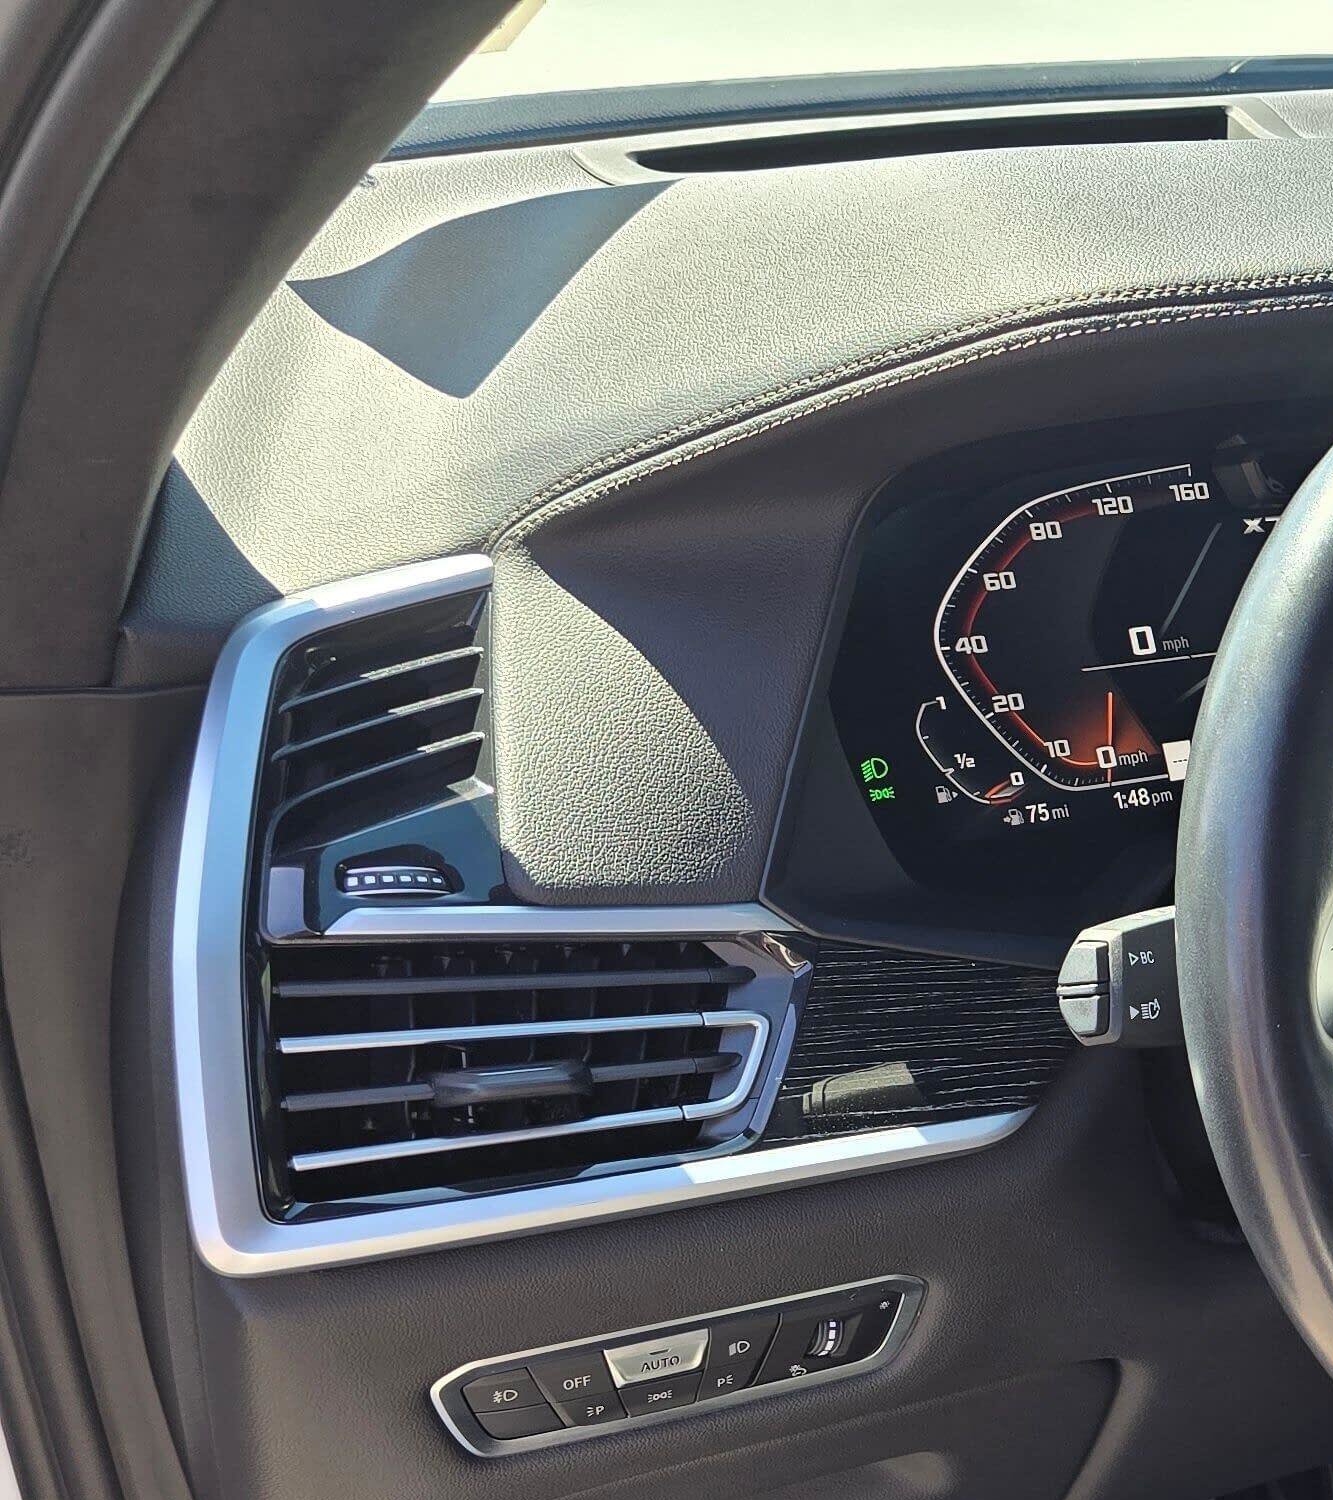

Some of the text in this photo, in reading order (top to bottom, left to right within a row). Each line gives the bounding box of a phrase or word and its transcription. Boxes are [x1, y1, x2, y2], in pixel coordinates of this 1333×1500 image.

[1169, 482, 1210, 502] 160
[1092, 496, 1134, 516] 120
[1029, 521, 1062, 541] 80
[983, 571, 1016, 591] 60
[955, 635, 988, 655] 40
[1129, 626, 1189, 656] 0 mph
[936, 696, 947, 710] 1
[992, 693, 1024, 712] 20
[1044, 739, 1070, 758] 10
[1096, 745, 1148, 768] 0 mph
[1010, 771, 1024, 786] 0
[1113, 788, 1173, 809] 1:48 pm
[1026, 803, 1070, 823] 75 mi
[1140, 950, 1155, 964] BC
[641, 1355, 680, 1373] AUTO
[563, 1374, 592, 1391] OFF
